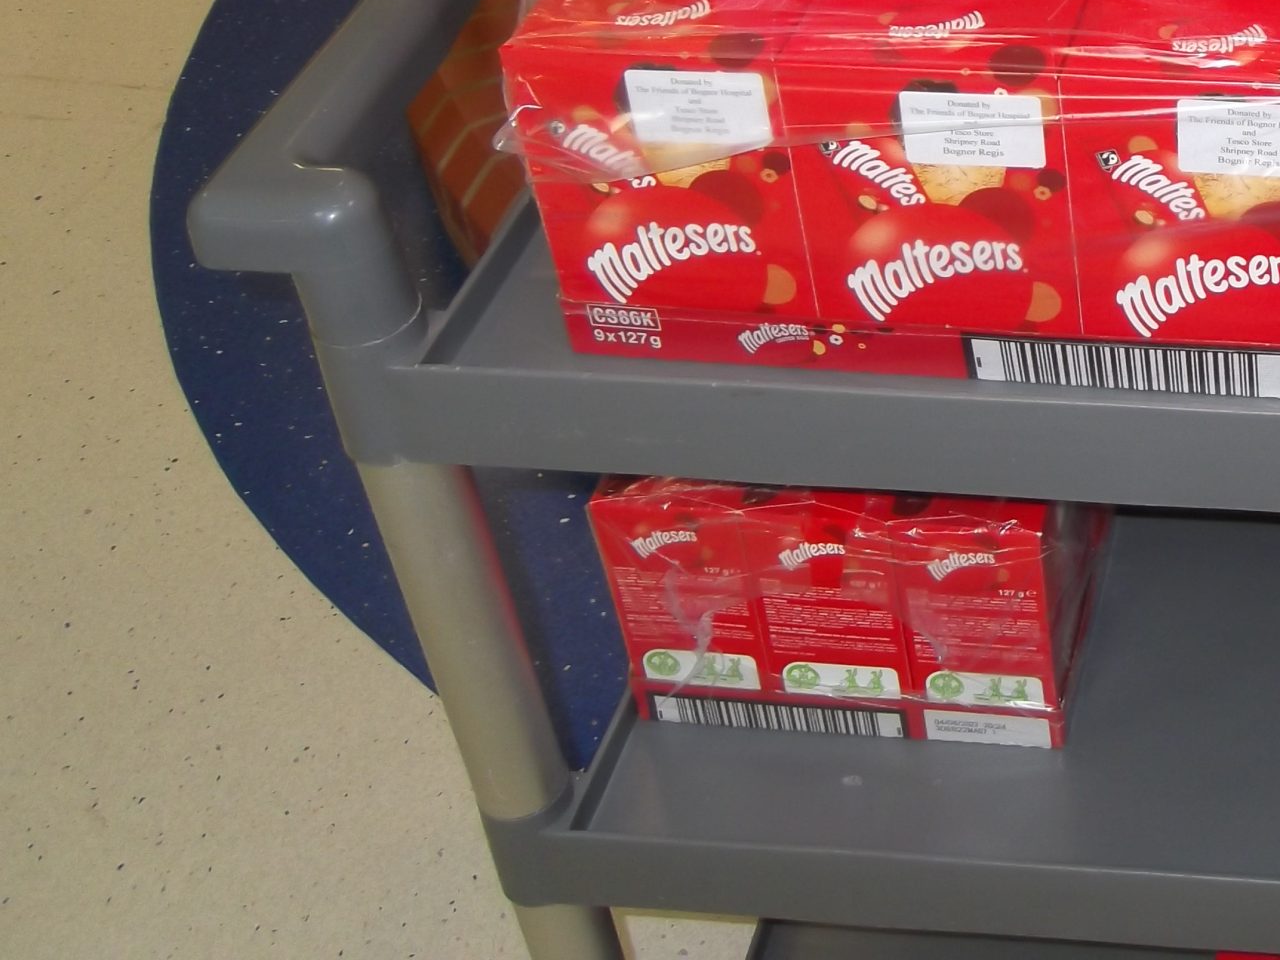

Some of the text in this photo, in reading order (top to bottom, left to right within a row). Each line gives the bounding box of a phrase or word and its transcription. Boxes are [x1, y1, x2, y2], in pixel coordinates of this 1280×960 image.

[616, 0, 711, 26] Maltesers
[889, 10, 985, 37] Maltesers
[1172, 24, 1268, 53] Maltesers
[1188, 116, 1202, 124] The
[1206, 118, 1234, 126] Friends
[1248, 120, 1276, 128] Bognor
[1228, 108, 1272, 119] Donated by
[1220, 146, 1278, 156] Shripney Road
[1227, 138, 1249, 146] Tesco
[832, 140, 926, 206] Maltes
[1111, 154, 1205, 221] Maltes
[587, 221, 759, 303] Maltesers
[848, 239, 1026, 322] Maltesers
[592, 307, 655, 327] CS66K
[738, 322, 809, 354] Maltesers
[631, 530, 697, 558] Maltesers
[779, 542, 845, 571] Maltesers
[926, 552, 995, 581] Maltesers
